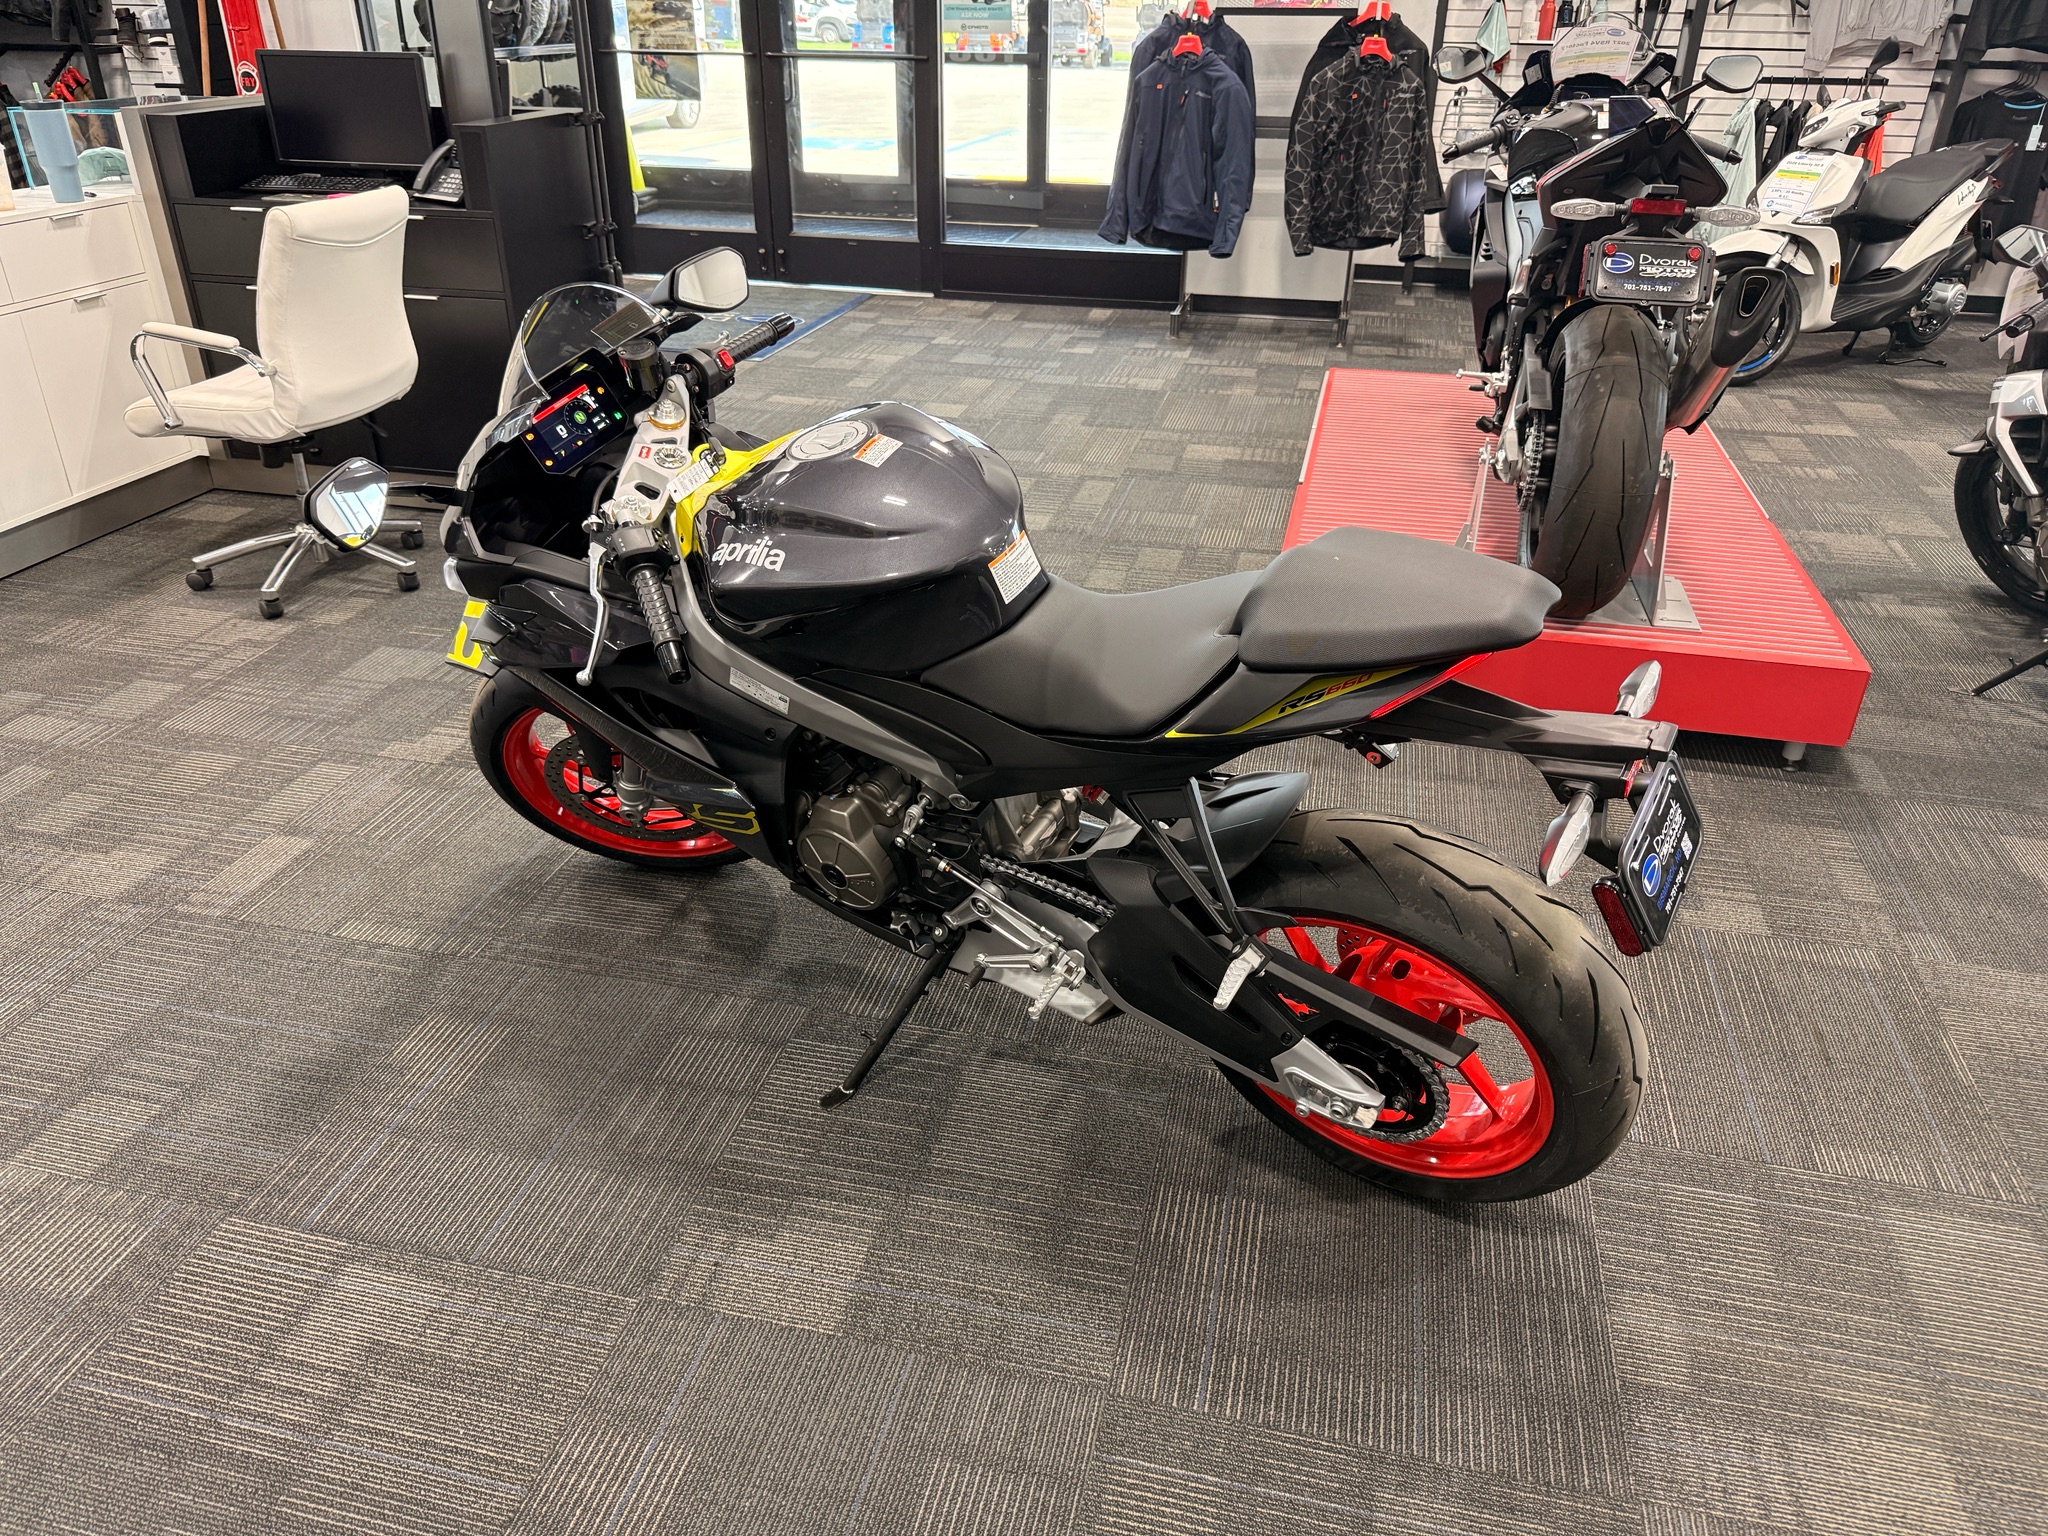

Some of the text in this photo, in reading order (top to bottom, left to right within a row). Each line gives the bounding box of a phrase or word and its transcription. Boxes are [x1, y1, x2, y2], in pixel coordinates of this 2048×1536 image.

[240, 77, 255, 87] FRY
[1639, 253, 1698, 269] Dvorak
[1639, 266, 1698, 274] MOTOR
[711, 535, 786, 571] aprilia
[1278, 672, 1375, 715] RS660
[1653, 798, 1680, 853] Dvorak
[1674, 848, 1683, 864] ND
